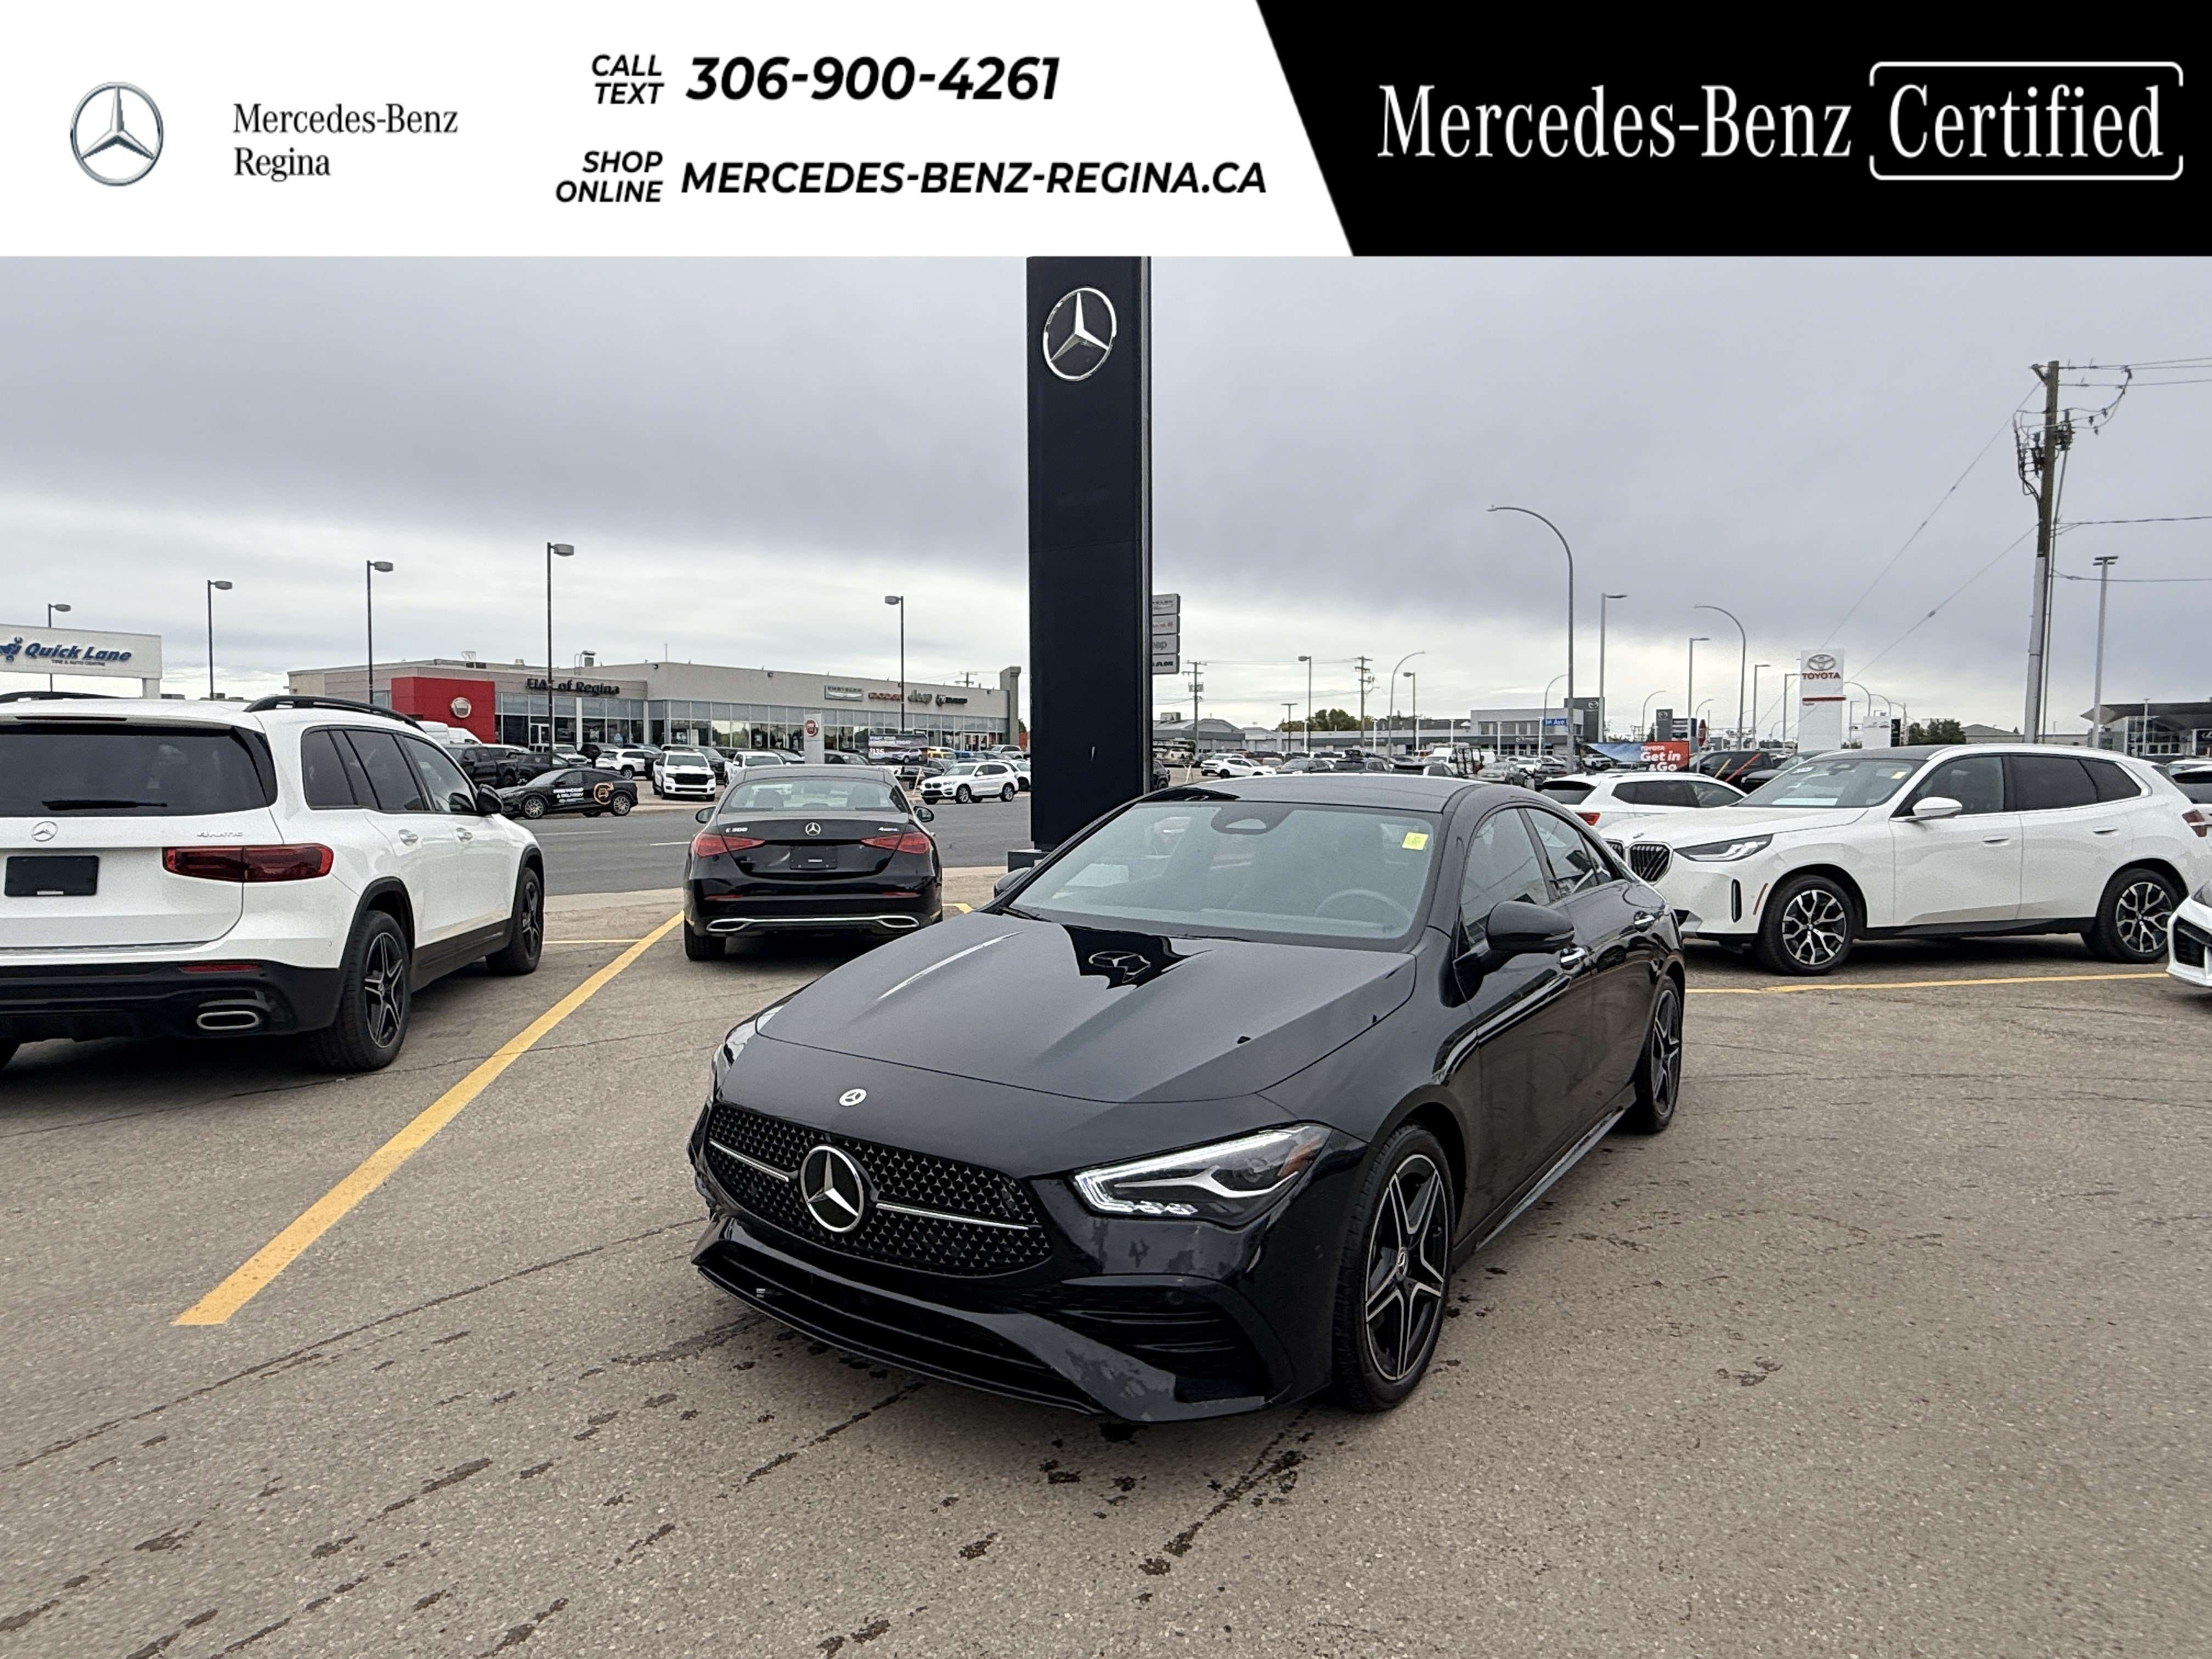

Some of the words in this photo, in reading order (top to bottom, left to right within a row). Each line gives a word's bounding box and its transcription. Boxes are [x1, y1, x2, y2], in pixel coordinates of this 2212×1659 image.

[25, 642, 82, 659] Quick
[83, 646, 132, 661] Lane
[558, 679, 573, 691] of
[576, 681, 620, 696] Regina
[1640, 752, 1666, 761] Get
[1667, 751, 1681, 761] in
